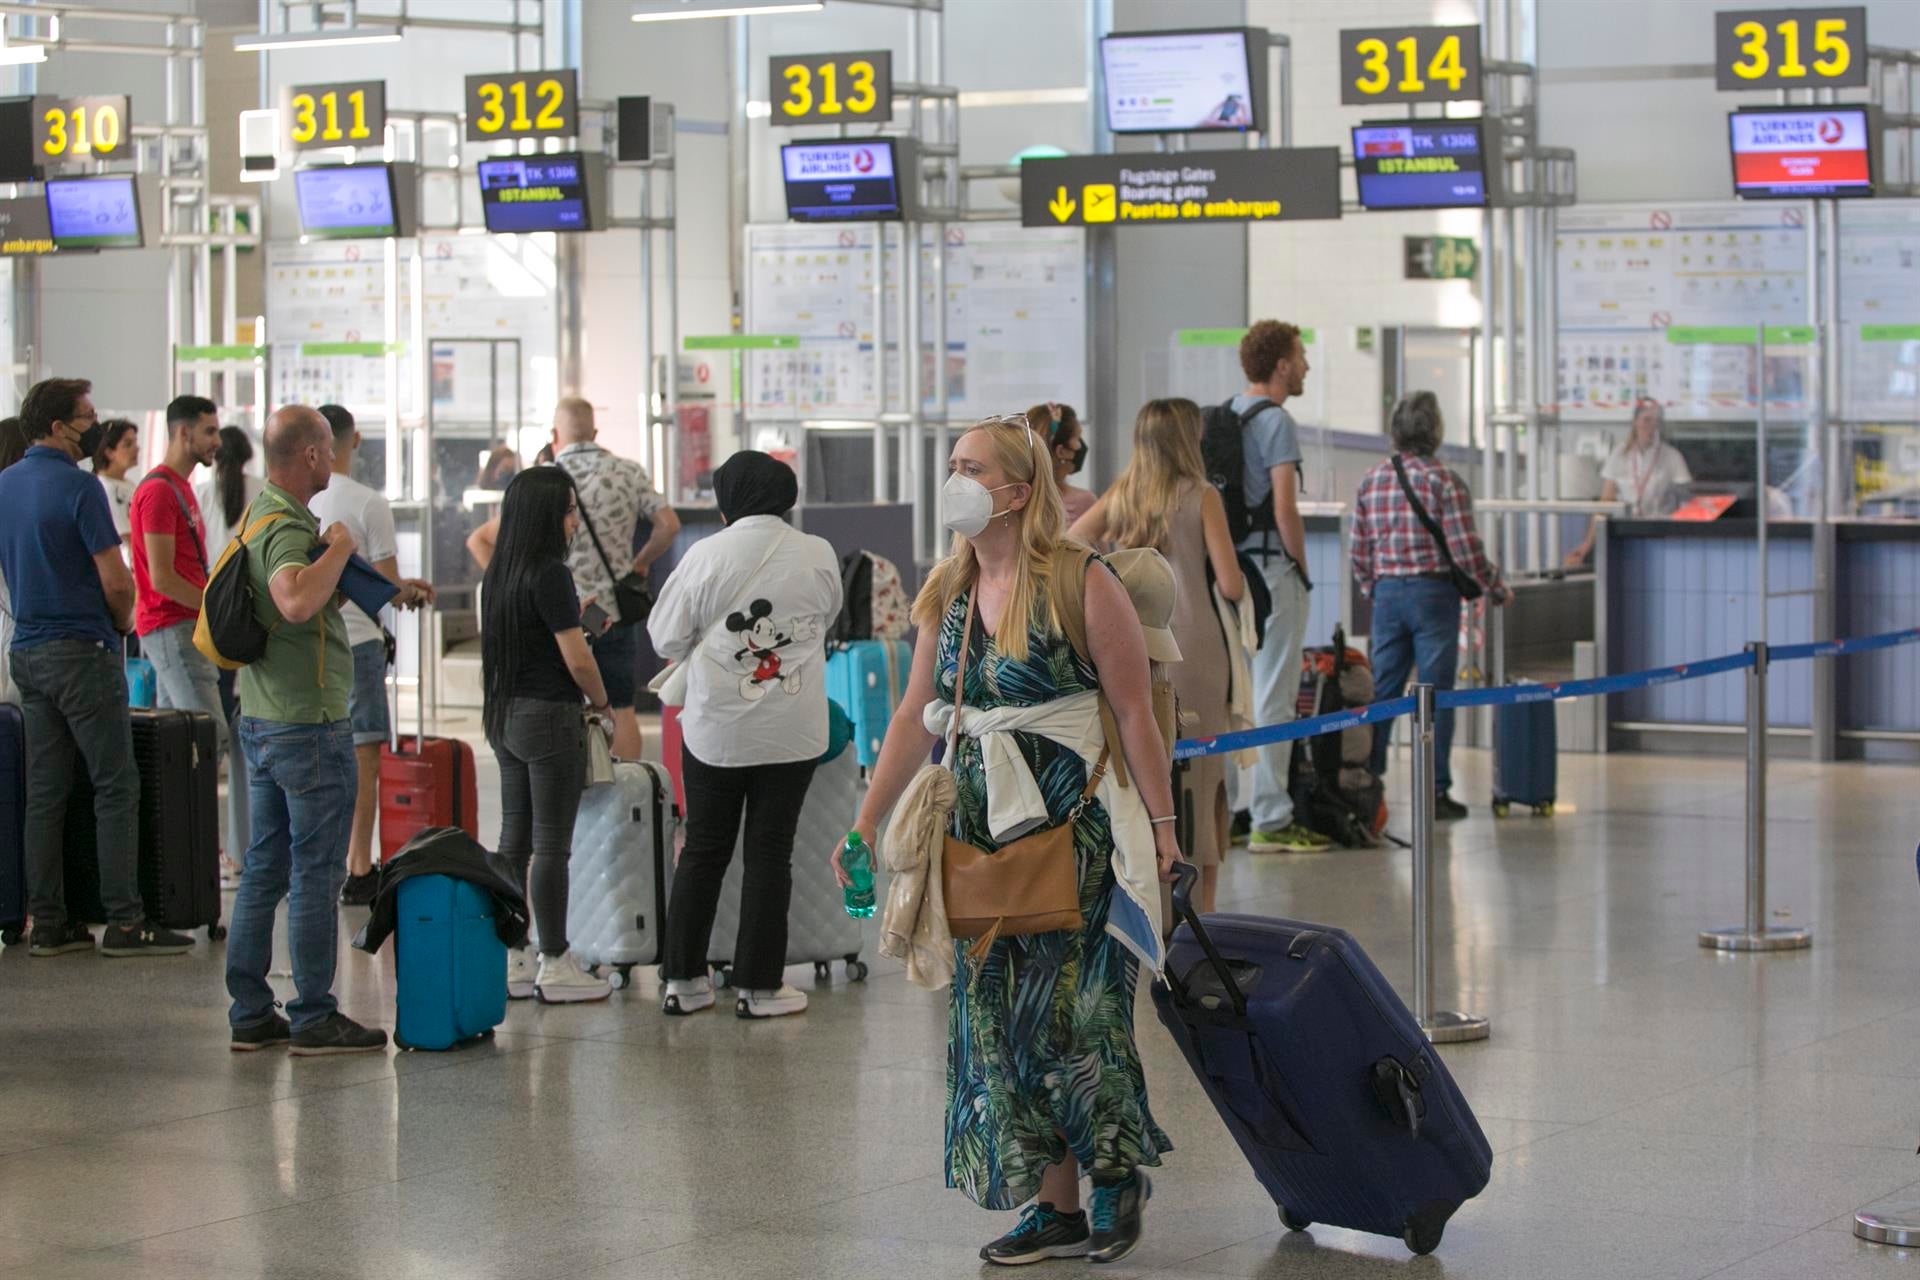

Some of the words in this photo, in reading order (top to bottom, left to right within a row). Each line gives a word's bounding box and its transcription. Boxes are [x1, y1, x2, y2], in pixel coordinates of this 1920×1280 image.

[1731, 18, 1851, 79] 315
[1355, 35, 1467, 95] 314
[782, 60, 877, 116] 313
[476, 79, 565, 133] 312
[290, 89, 371, 144] 311
[43, 105, 120, 156] 310
[1751, 120, 1815, 132] TURKISH
[1413, 134, 1434, 149] TK
[1751, 133, 1816, 145] AIRLINES
[799, 151, 850, 162] TURKISH
[1377, 156, 1460, 174] ISTANBUL
[526, 166, 543, 179] TK
[800, 162, 852, 174] AIRLINES
[1119, 168, 1179, 186] Flugsteige
[1180, 166, 1216, 183] Gates
[498, 186, 565, 203] ISTANBUL
[1119, 184, 1173, 202] Boarding
[1173, 184, 1208, 201] gates
[1120, 201, 1179, 219] Puertas
[1180, 200, 1201, 218] de
[1202, 198, 1281, 219] embarque
